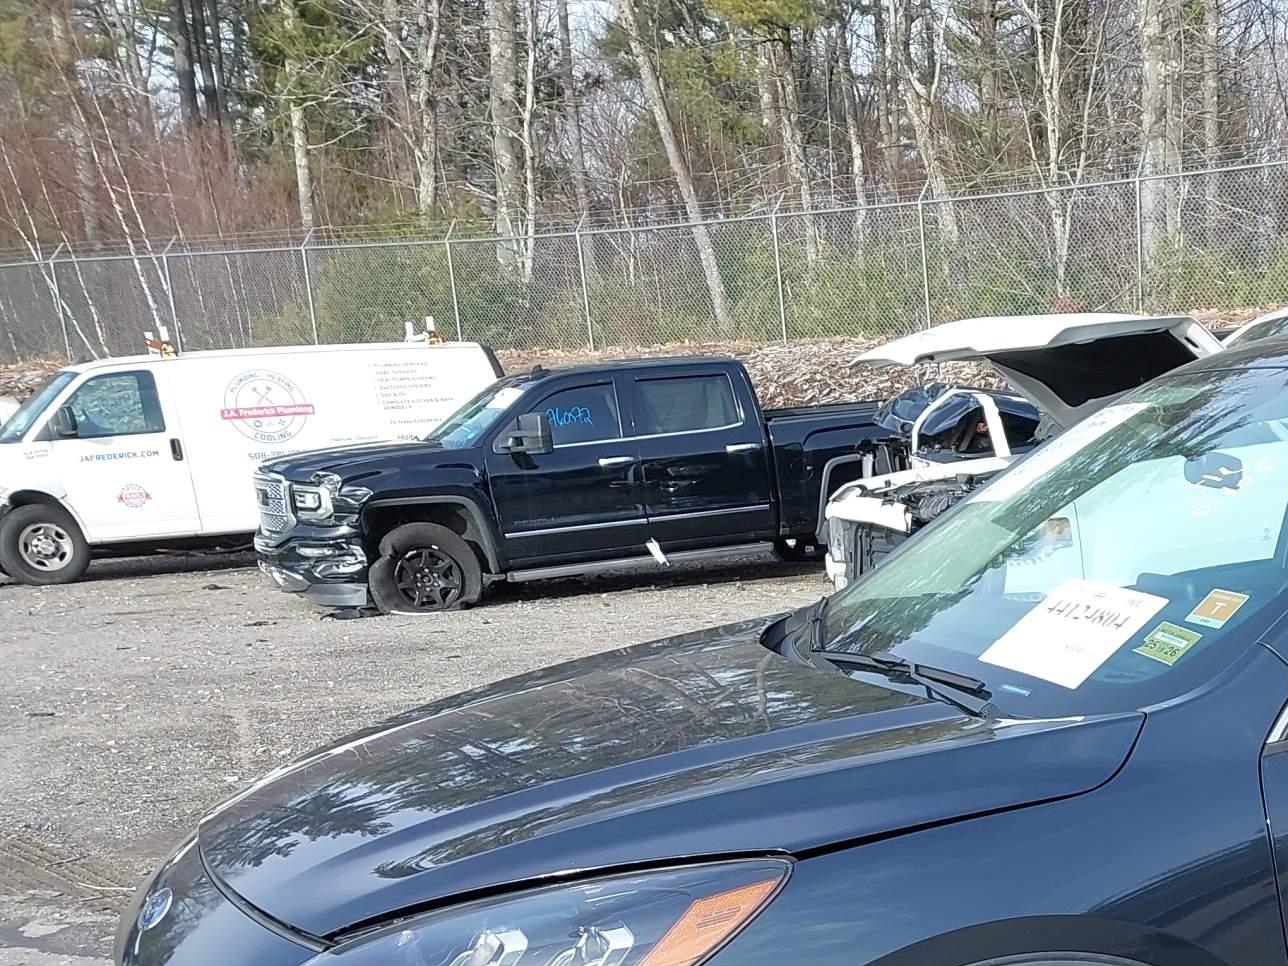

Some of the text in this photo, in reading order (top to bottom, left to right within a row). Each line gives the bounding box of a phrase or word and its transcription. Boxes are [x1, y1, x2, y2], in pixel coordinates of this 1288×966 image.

[239, 407, 275, 416] Frederick
[277, 405, 313, 414] Plumbing
[254, 430, 291, 441] COOLING
[80, 450, 159, 463] JAFREDERICK.COM
[1047, 600, 1132, 630] 44124804
